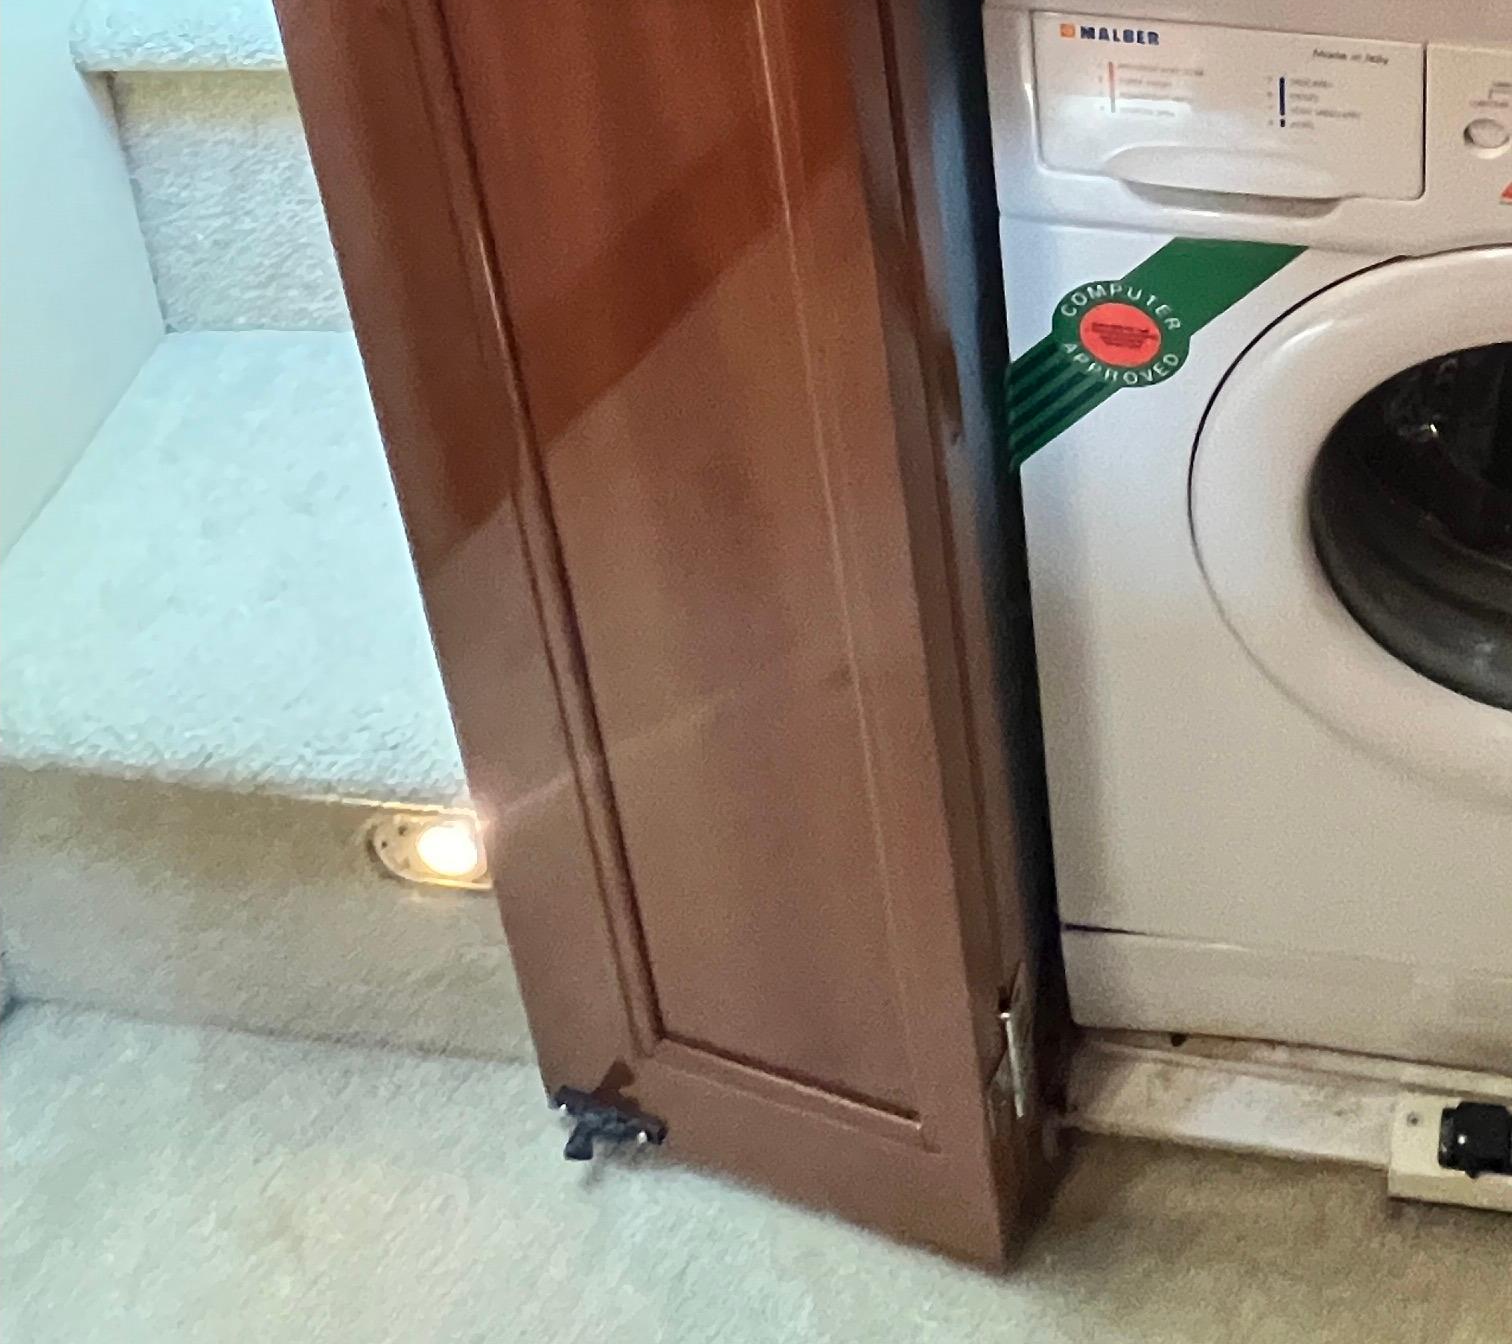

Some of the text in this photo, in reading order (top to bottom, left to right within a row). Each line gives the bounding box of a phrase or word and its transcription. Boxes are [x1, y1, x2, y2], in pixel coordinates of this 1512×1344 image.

[1080, 25, 1160, 46] MALBER
[1061, 283, 1181, 330] COMPUTER
[1063, 343, 1179, 385] APPROVED
